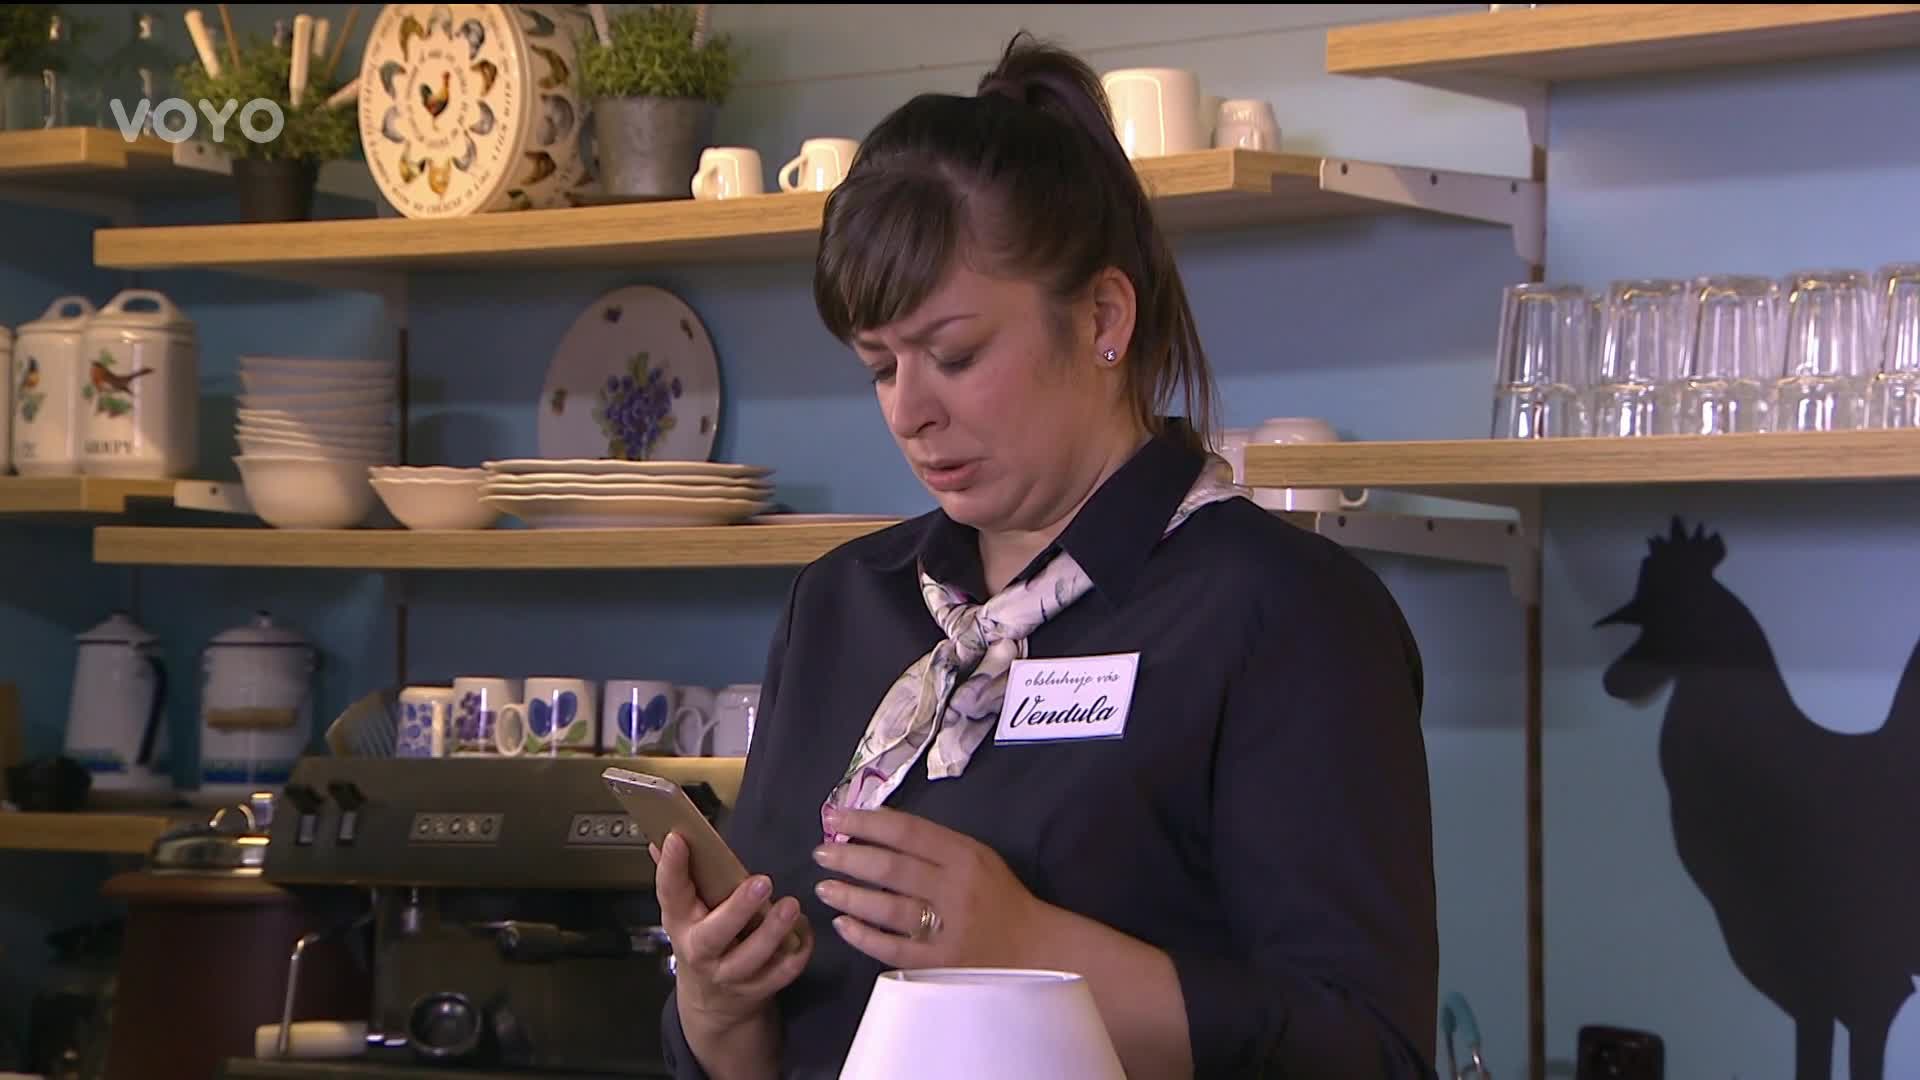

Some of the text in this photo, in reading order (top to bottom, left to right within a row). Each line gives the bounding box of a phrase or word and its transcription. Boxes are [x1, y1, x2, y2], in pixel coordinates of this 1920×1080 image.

[1024, 670, 1120, 693] obsluhuje vás
[1010, 695, 1119, 728] Vendula
